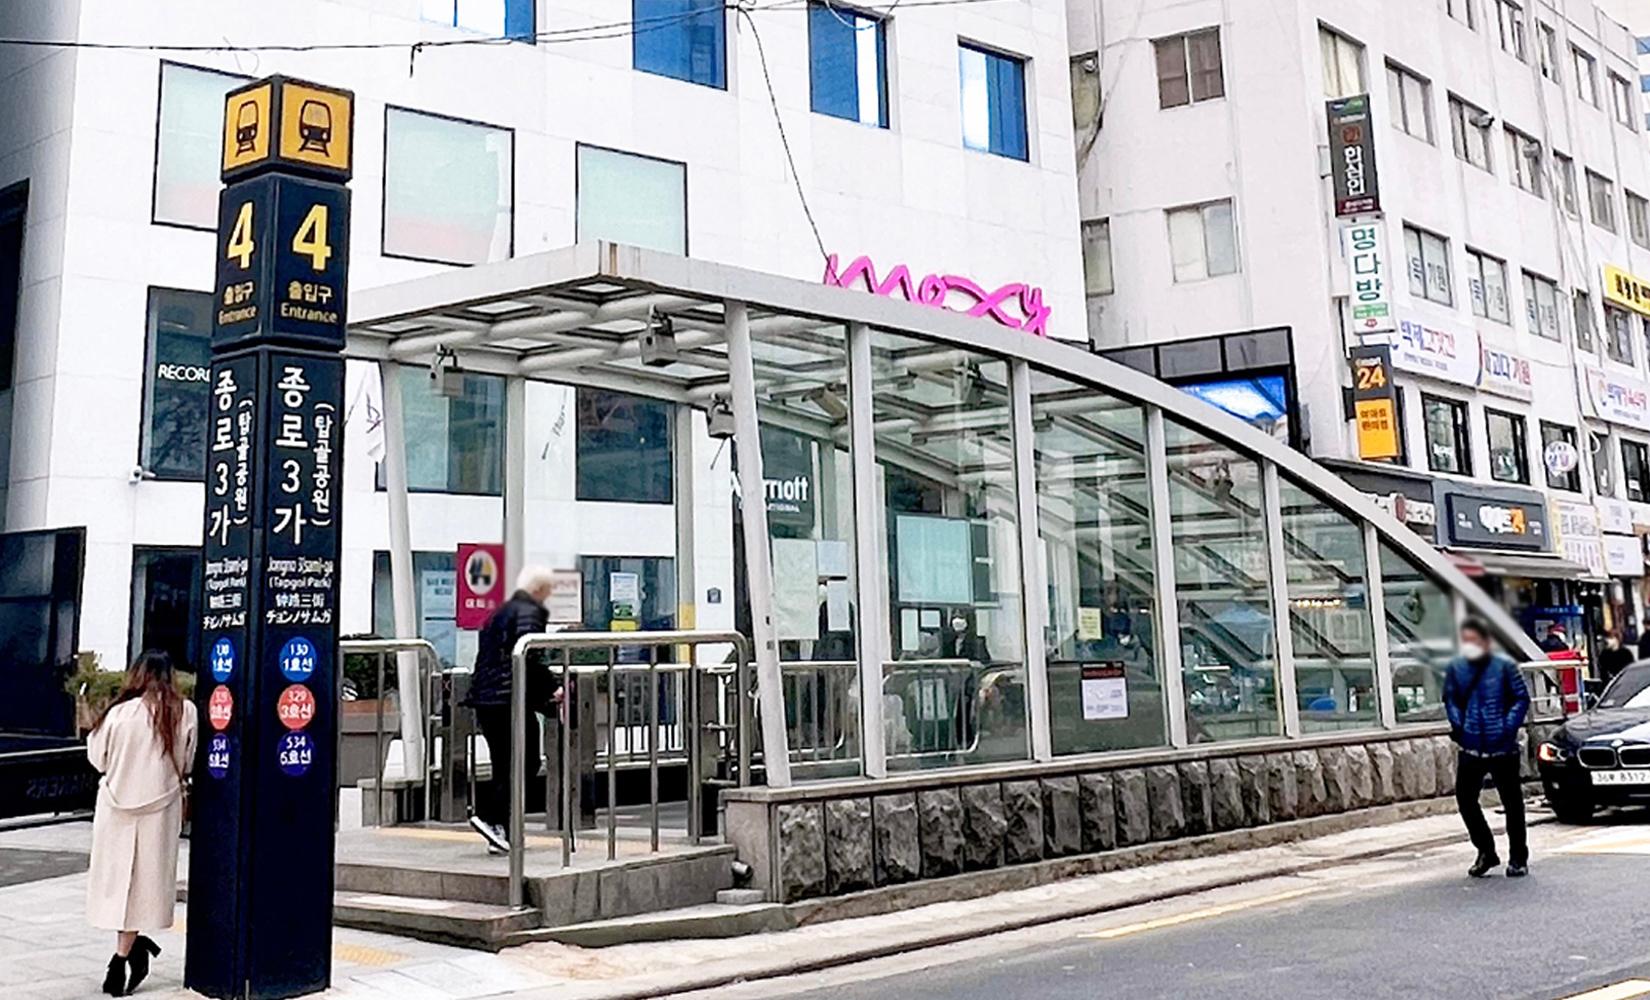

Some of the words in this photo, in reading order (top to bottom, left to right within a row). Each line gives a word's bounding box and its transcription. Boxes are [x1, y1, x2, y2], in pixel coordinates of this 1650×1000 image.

[227, 202, 255, 270] 4
[293, 203, 332, 271] 4
[1351, 228, 1382, 301] 명다방
[223, 280, 254, 305] 출입구
[288, 279, 333, 305] 출입구
[218, 304, 257, 326] Entrance
[280, 302, 338, 324] Entrance
[158, 363, 211, 383] RECOR
[1356, 366, 1387, 391] 24
[209, 369, 238, 547] 종로3가
[272, 366, 311, 545] 종로3가
[311, 402, 336, 527] (탑골공원)
[267, 556, 297, 577] Jongno
[269, 576, 306, 590] (Tapgol
[307, 577, 332, 590] Park)
[289, 643, 309, 656] 130
[283, 657, 313, 672] 1호선
[281, 703, 312, 720] 3호선
[286, 736, 307, 749] 534
[280, 749, 312, 765] 5호선
